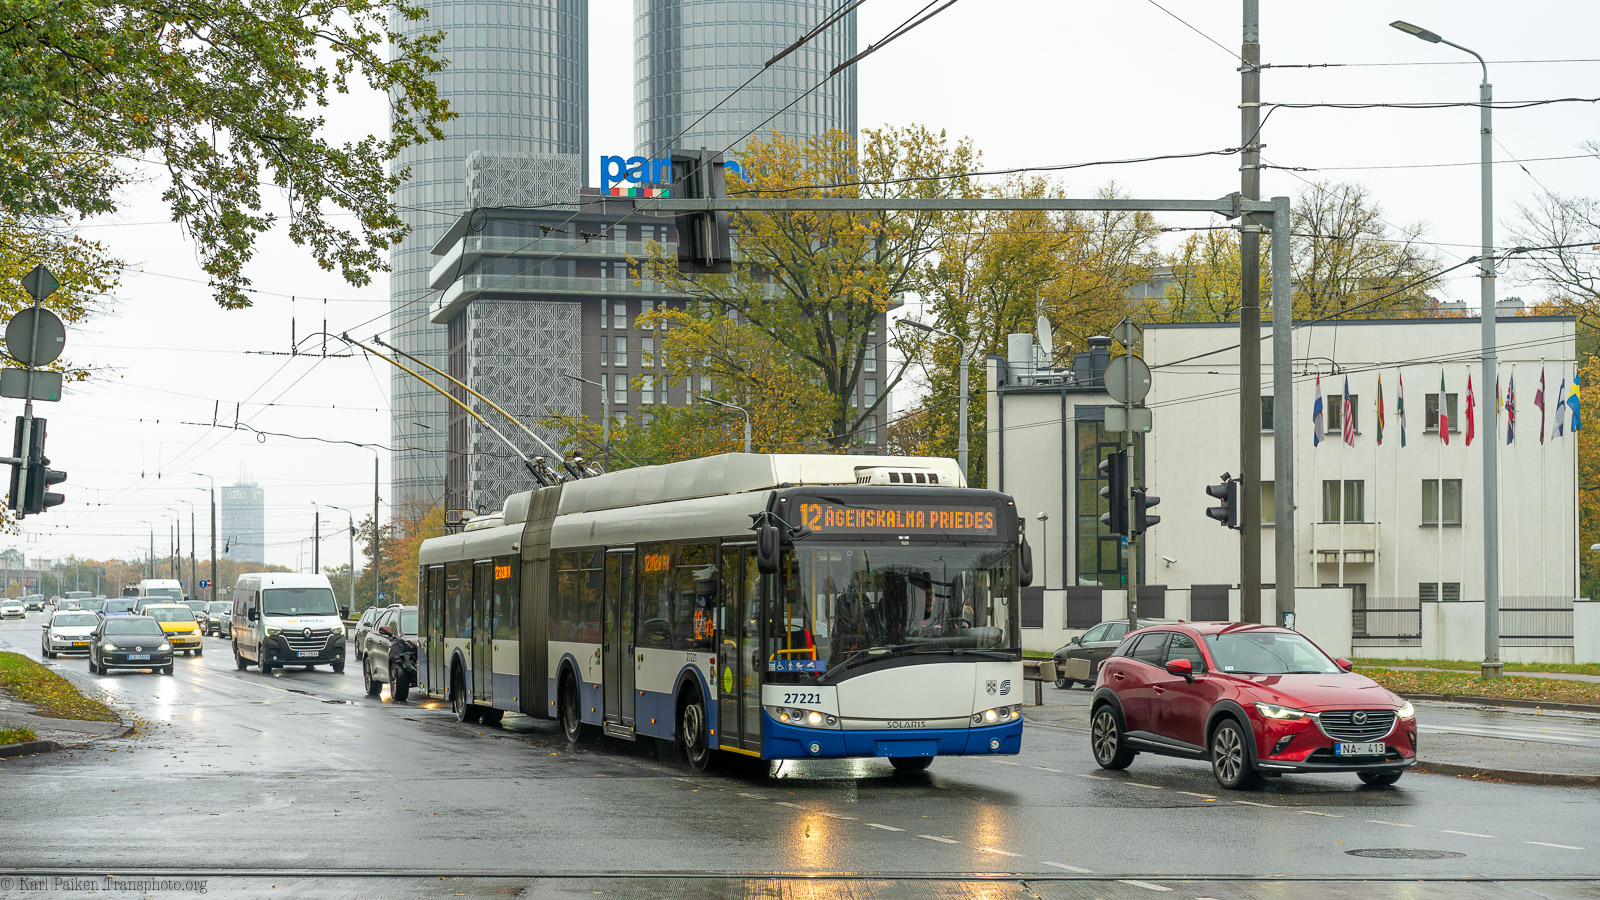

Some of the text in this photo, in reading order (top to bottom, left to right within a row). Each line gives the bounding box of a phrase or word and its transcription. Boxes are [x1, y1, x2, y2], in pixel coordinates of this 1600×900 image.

[600, 150, 673, 195] par
[800, 503, 823, 531] 12
[930, 510, 994, 529] PRIEDES
[784, 693, 821, 704] 27221
[887, 721, 926, 729] SOLARIS
[1368, 743, 1384, 753] 413
